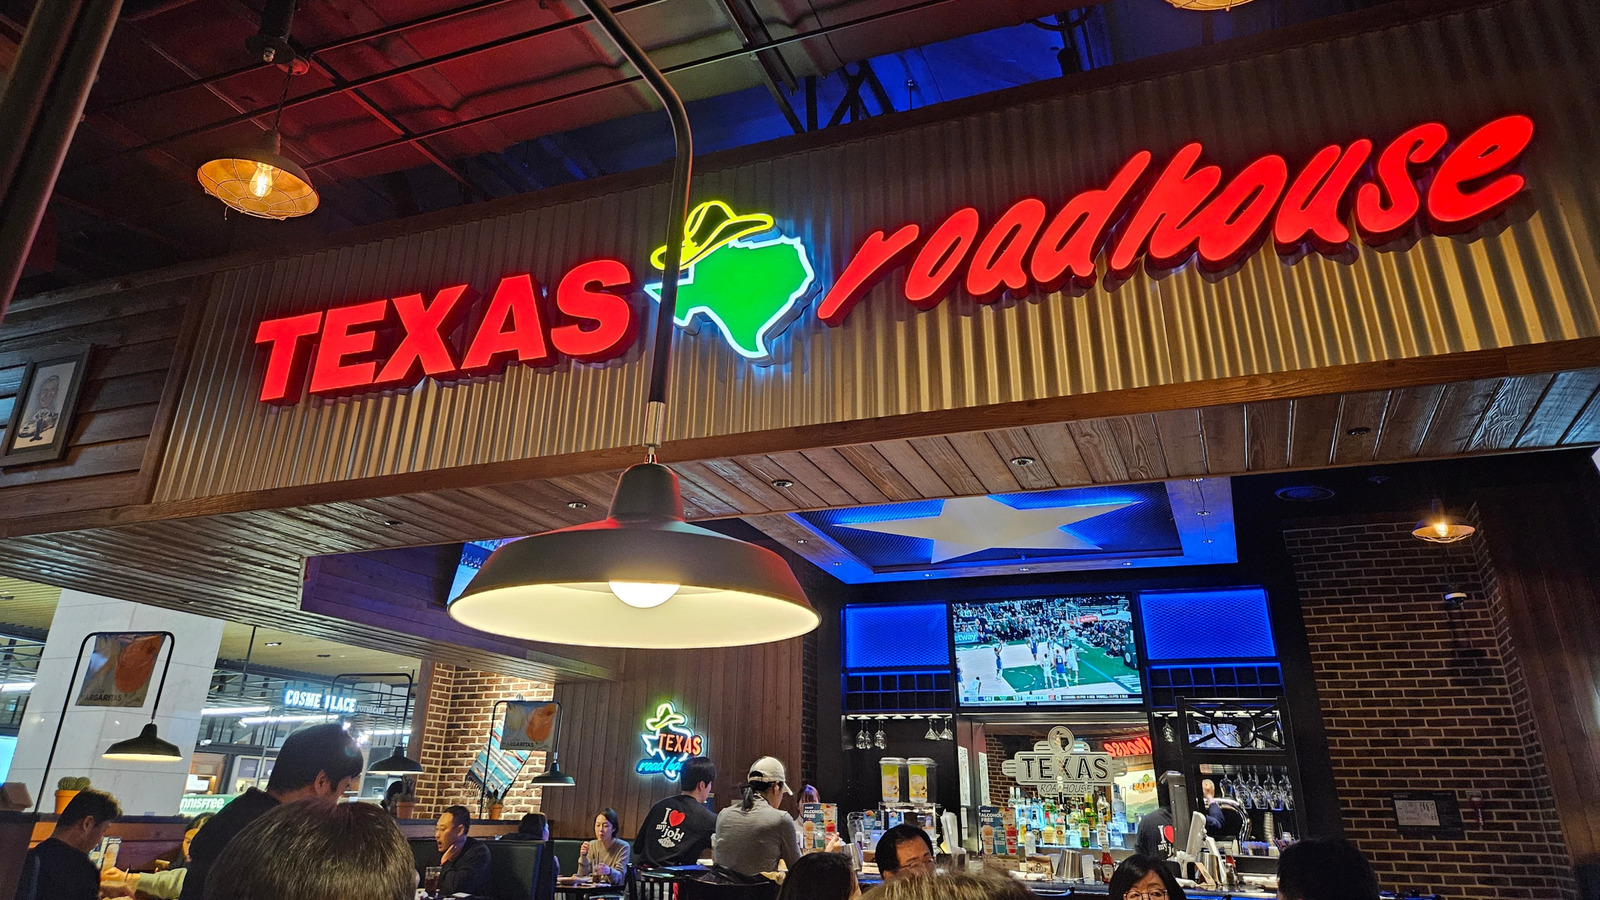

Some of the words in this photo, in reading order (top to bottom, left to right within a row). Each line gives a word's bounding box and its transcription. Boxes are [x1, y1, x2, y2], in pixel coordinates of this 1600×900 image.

[255, 259, 633, 402] TEXAS
[817, 114, 1535, 320] roadhouse
[284, 690, 322, 708] COSME
[659, 733, 702, 755] TEXAS
[638, 756, 682, 772] roadho
[1020, 756, 1109, 780] TEXAS
[1040, 784, 1093, 793] ROAHOUSE
[660, 807, 672, 825] I
[655, 824, 667, 832] my
[661, 825, 685, 843] job!
[1158, 824, 1167, 844] I
